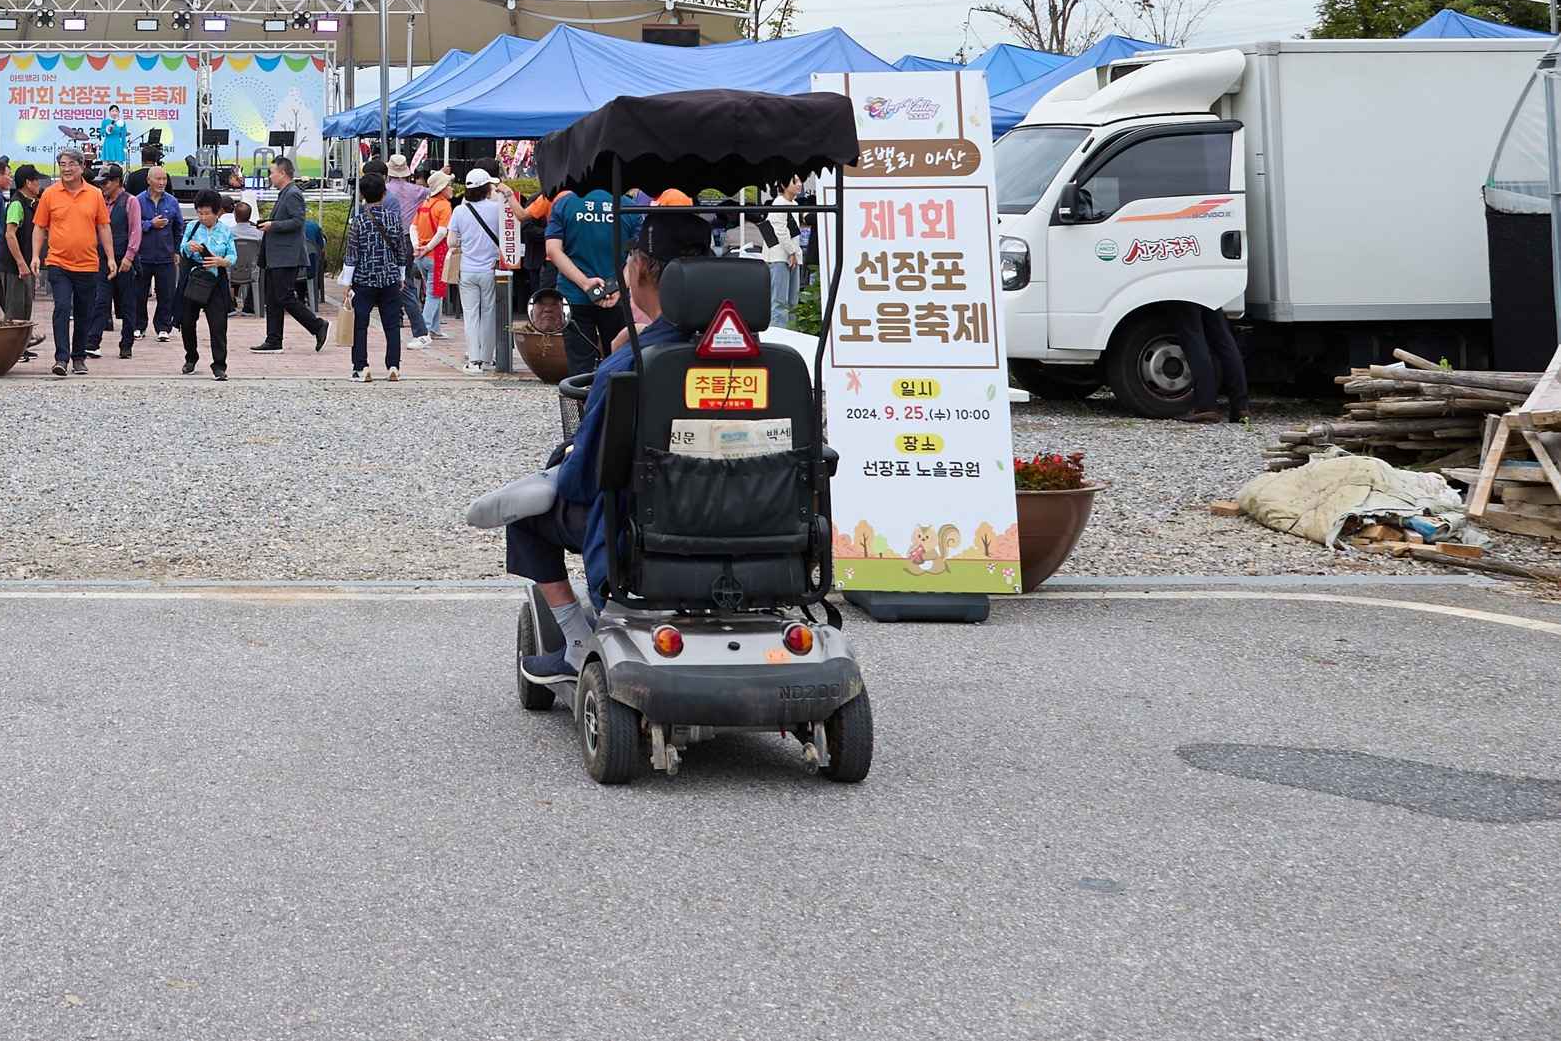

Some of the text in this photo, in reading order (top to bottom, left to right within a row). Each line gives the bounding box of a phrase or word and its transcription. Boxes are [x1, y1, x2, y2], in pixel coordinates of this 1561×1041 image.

[8, 85, 187, 105] 제1회 선장포 노을축제
[18, 106, 50, 121] 제7회
[136, 109, 179, 121] 주민총회
[858, 146, 967, 174] 트밸리 아산
[575, 212, 615, 223] POLIC
[859, 199, 956, 241] 제1회
[854, 250, 967, 291] 선장포
[839, 301, 990, 343] 노을축제
[695, 375, 758, 394] 추돌주의
[900, 381, 933, 397] 일시
[846, 408, 881, 421] 2024.
[884, 406, 900, 421] 9.
[955, 408, 990, 421] 10:00
[903, 435, 937, 451] 장소
[863, 460, 981, 478] 선장포 노을공원
